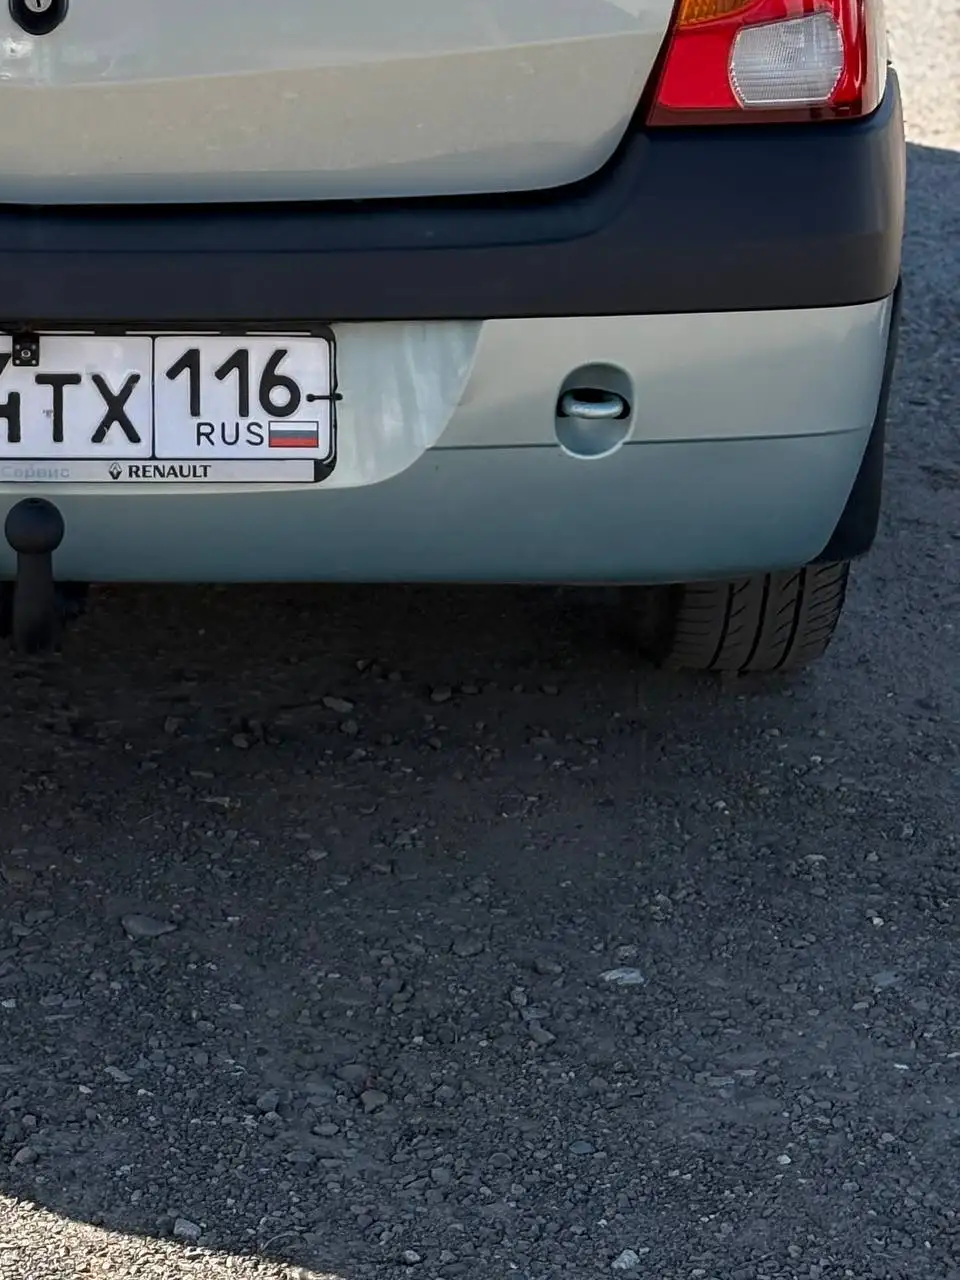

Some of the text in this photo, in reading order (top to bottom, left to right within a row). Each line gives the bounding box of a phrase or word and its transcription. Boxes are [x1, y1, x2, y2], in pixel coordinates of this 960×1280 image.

[166, 348, 301, 418] 116
[196, 422, 264, 446] RUS
[128, 464, 211, 479] RENAULT
